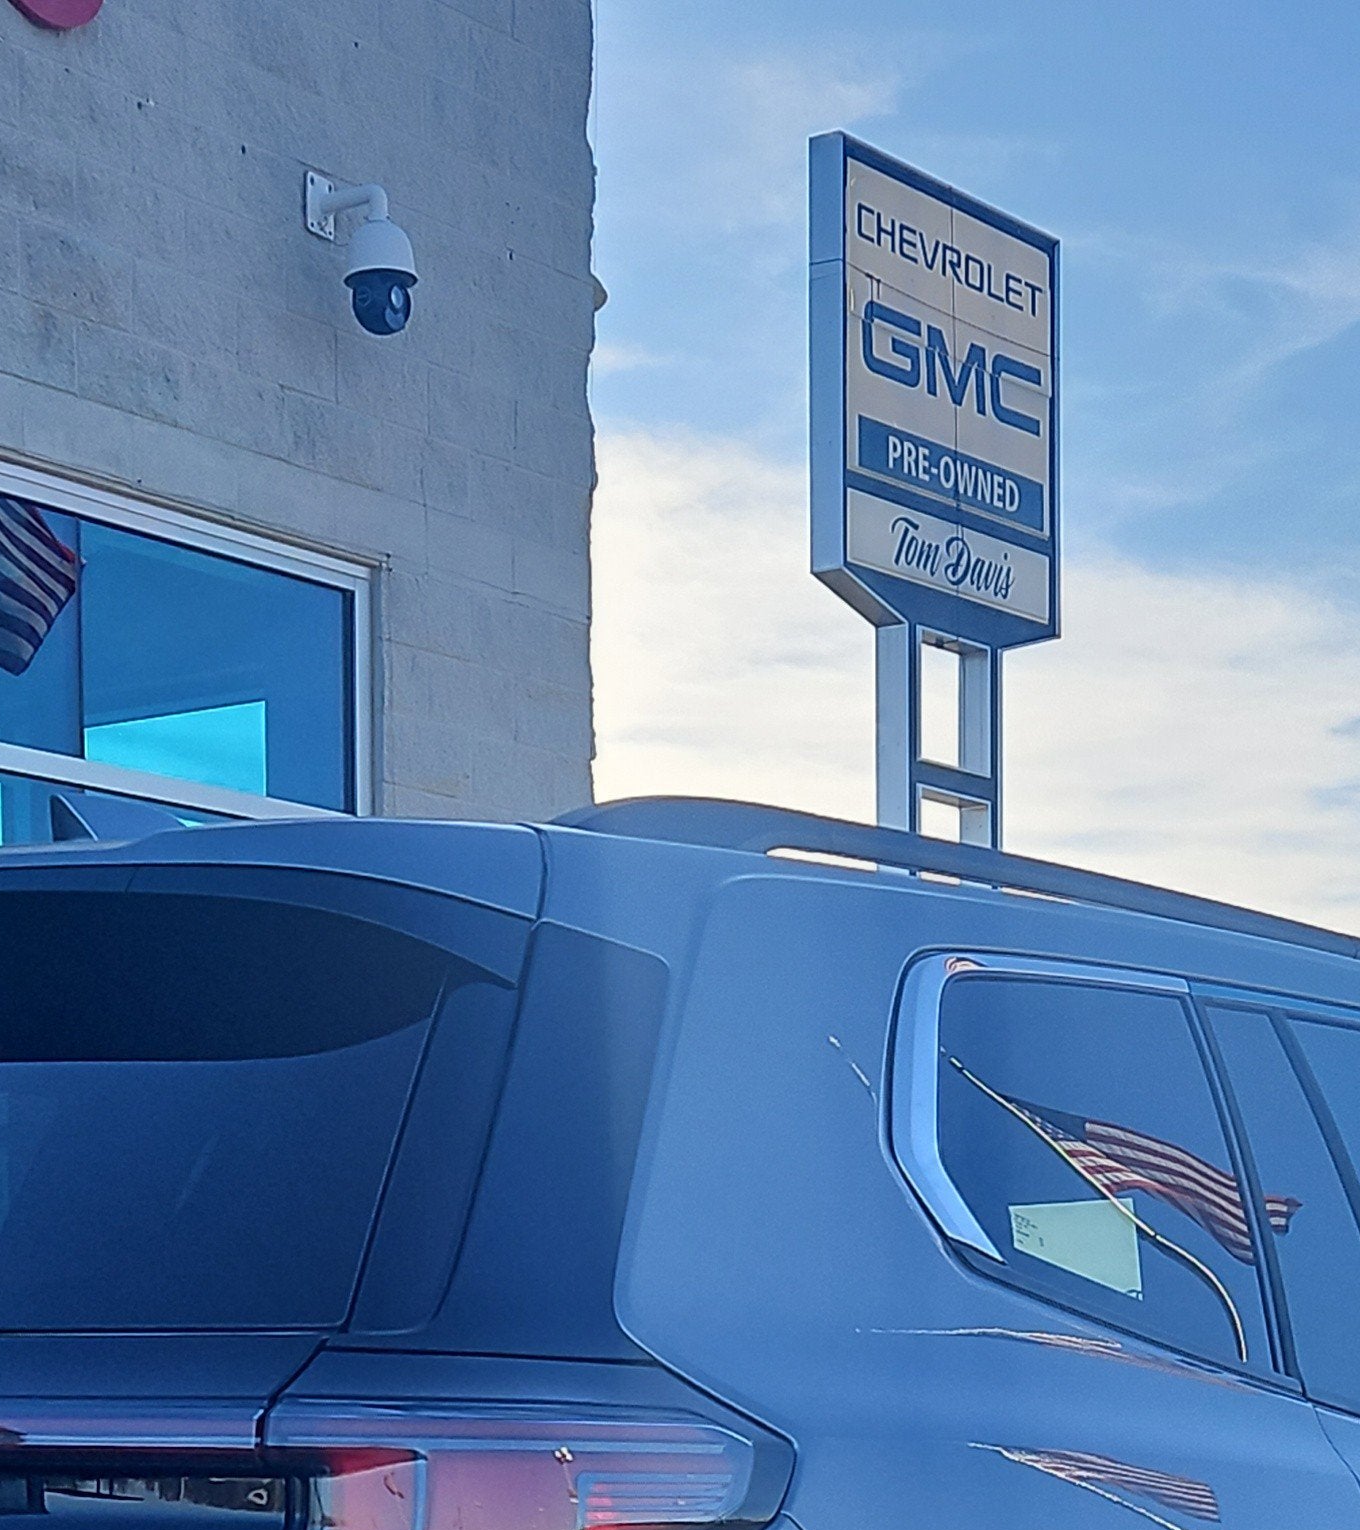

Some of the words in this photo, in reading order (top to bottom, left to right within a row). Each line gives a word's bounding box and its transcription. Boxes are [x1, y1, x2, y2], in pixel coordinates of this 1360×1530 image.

[856, 202, 1043, 317] CHEVROLET
[862, 300, 1041, 437] GMC
[887, 435, 1021, 513] PRE-OWNED
[890, 516, 943, 577] Tom
[944, 535, 1015, 600] Davis
